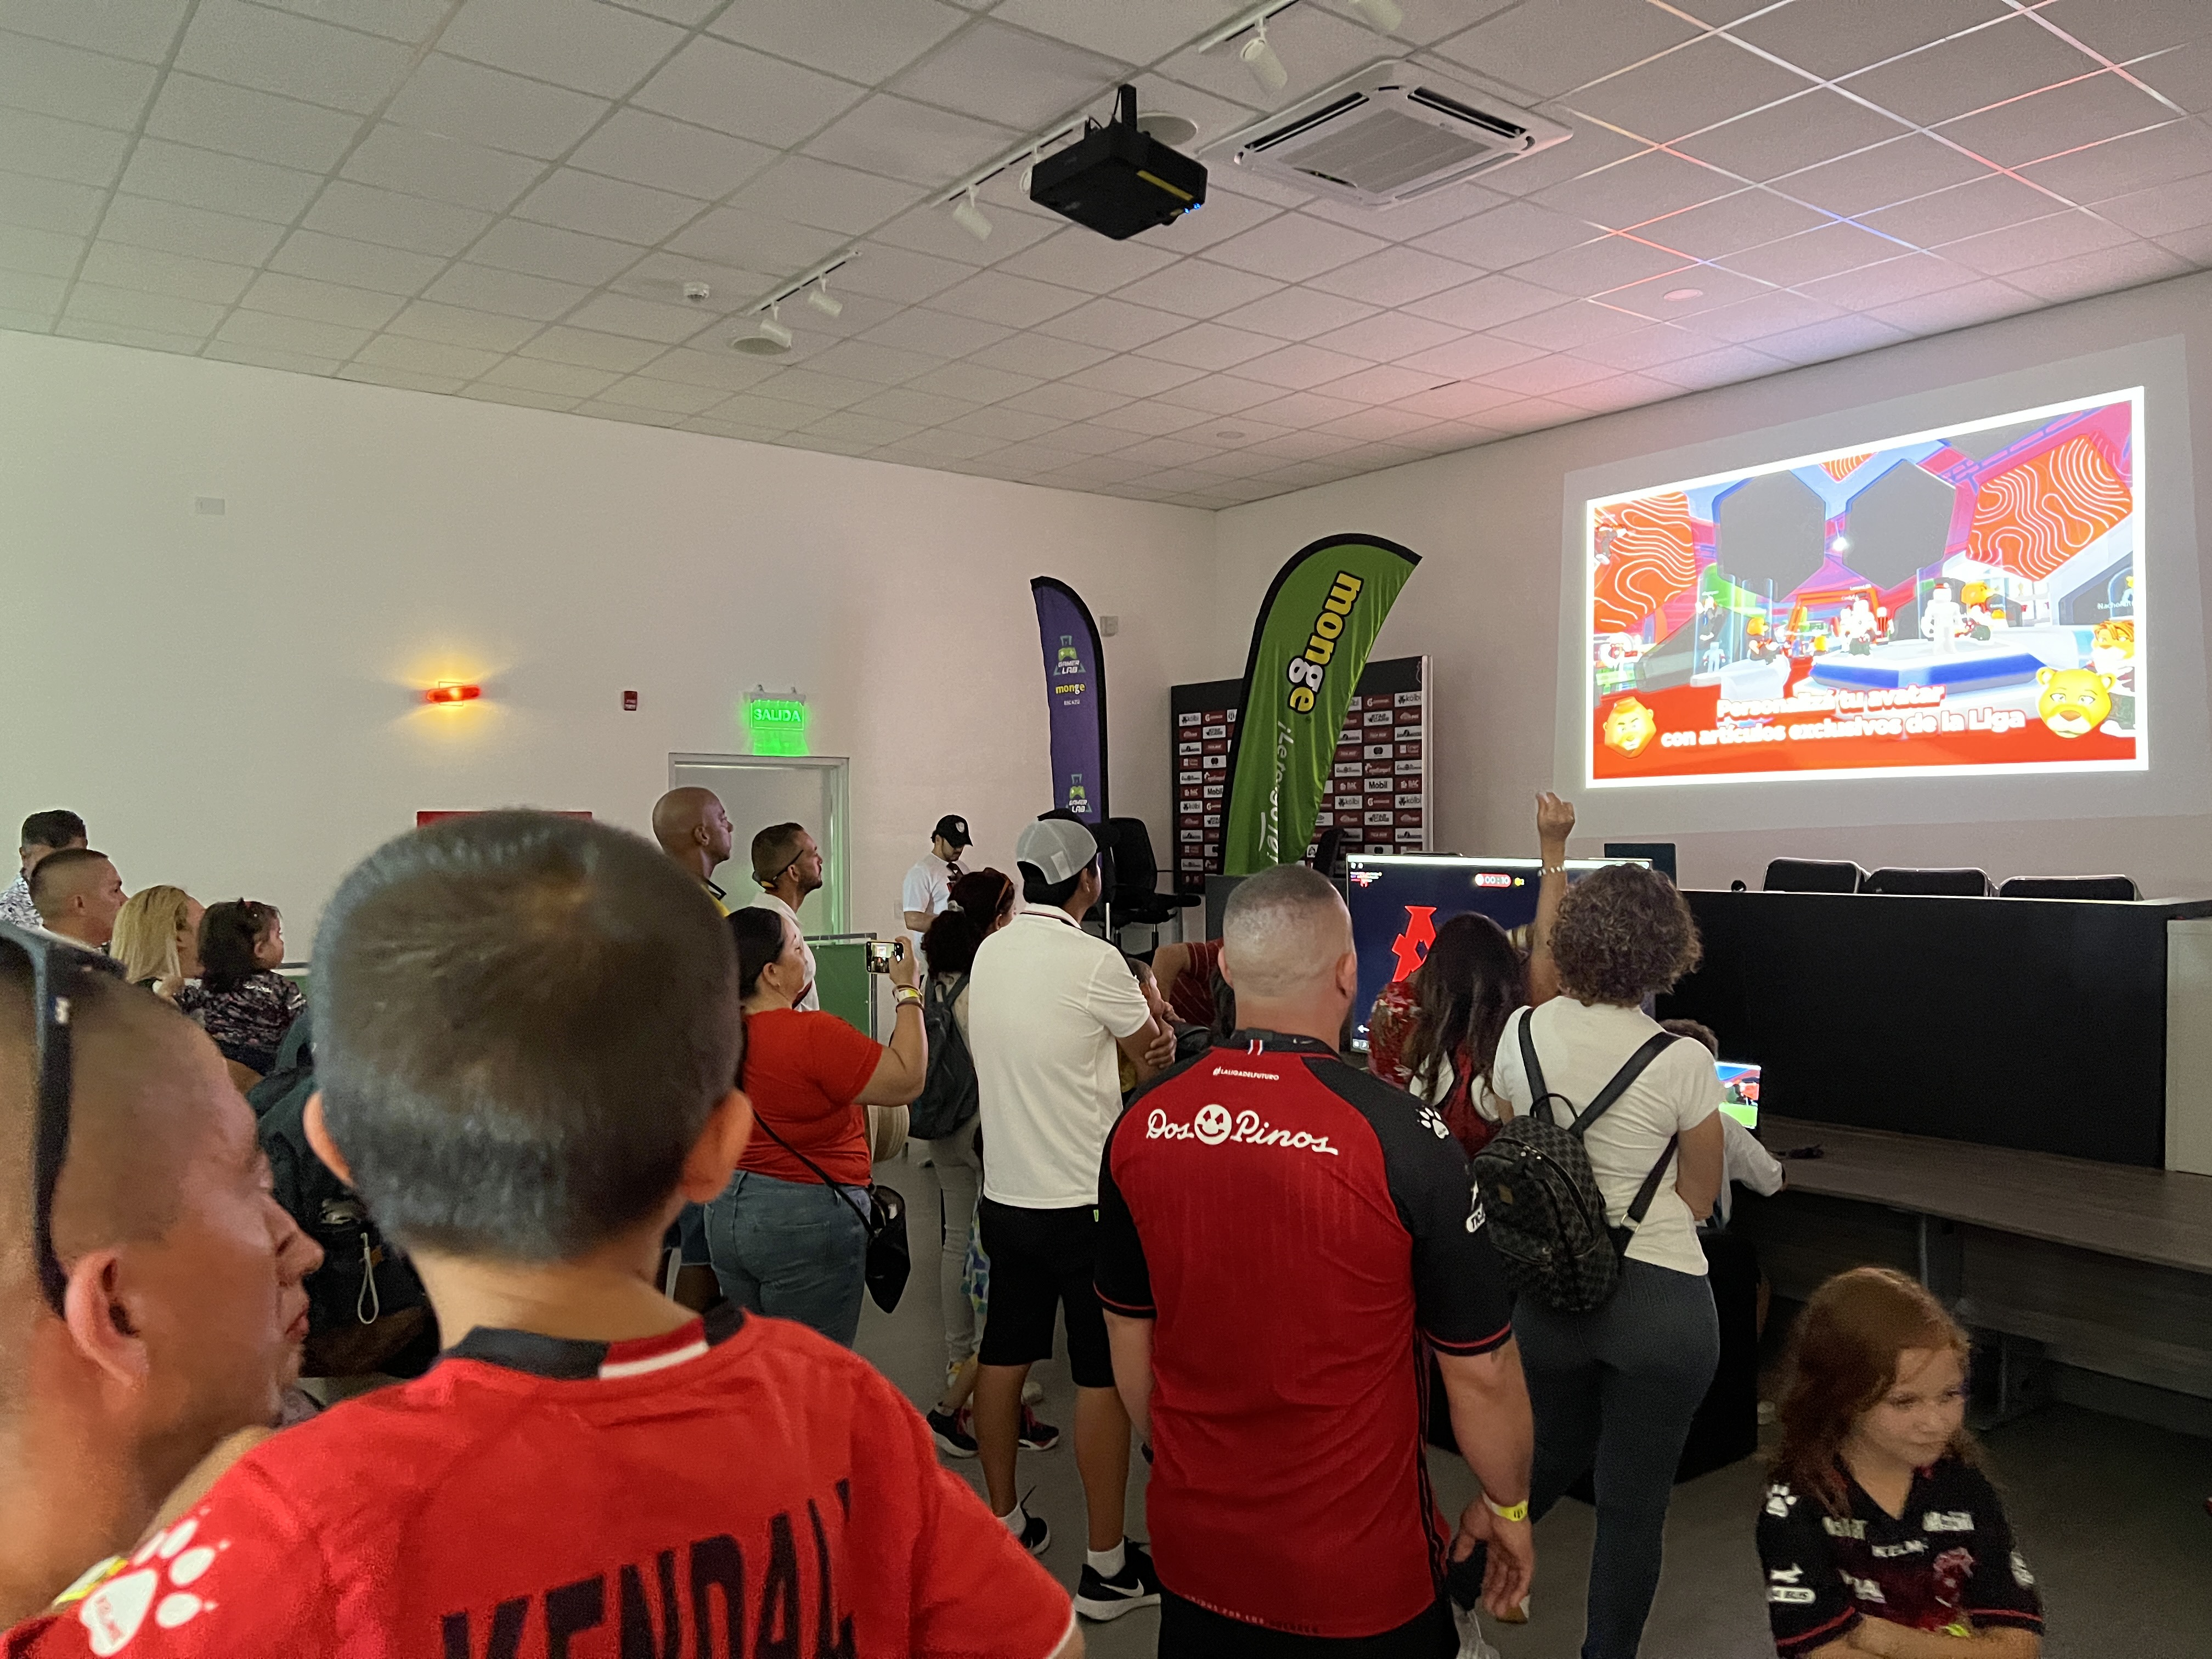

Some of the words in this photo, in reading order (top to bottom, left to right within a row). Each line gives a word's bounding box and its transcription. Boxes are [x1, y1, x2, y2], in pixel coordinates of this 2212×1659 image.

[1288, 572, 1363, 713] monge
[1062, 666, 1078, 674] LAB
[1055, 683, 1086, 695] monge
[1838, 690, 1865, 709] tu
[1867, 684, 1945, 708] avatar
[753, 708, 801, 722] SALIDA
[1661, 730, 1697, 748] con
[1788, 715, 1903, 741] exclusivos
[1905, 712, 1938, 733] de
[1941, 710, 1965, 732] la
[1968, 708, 2025, 733] Liga
[1369, 781, 1388, 789] Mobil
[1146, 1108, 1194, 1140] Dos
[1229, 1110, 1339, 1156] Pinos
